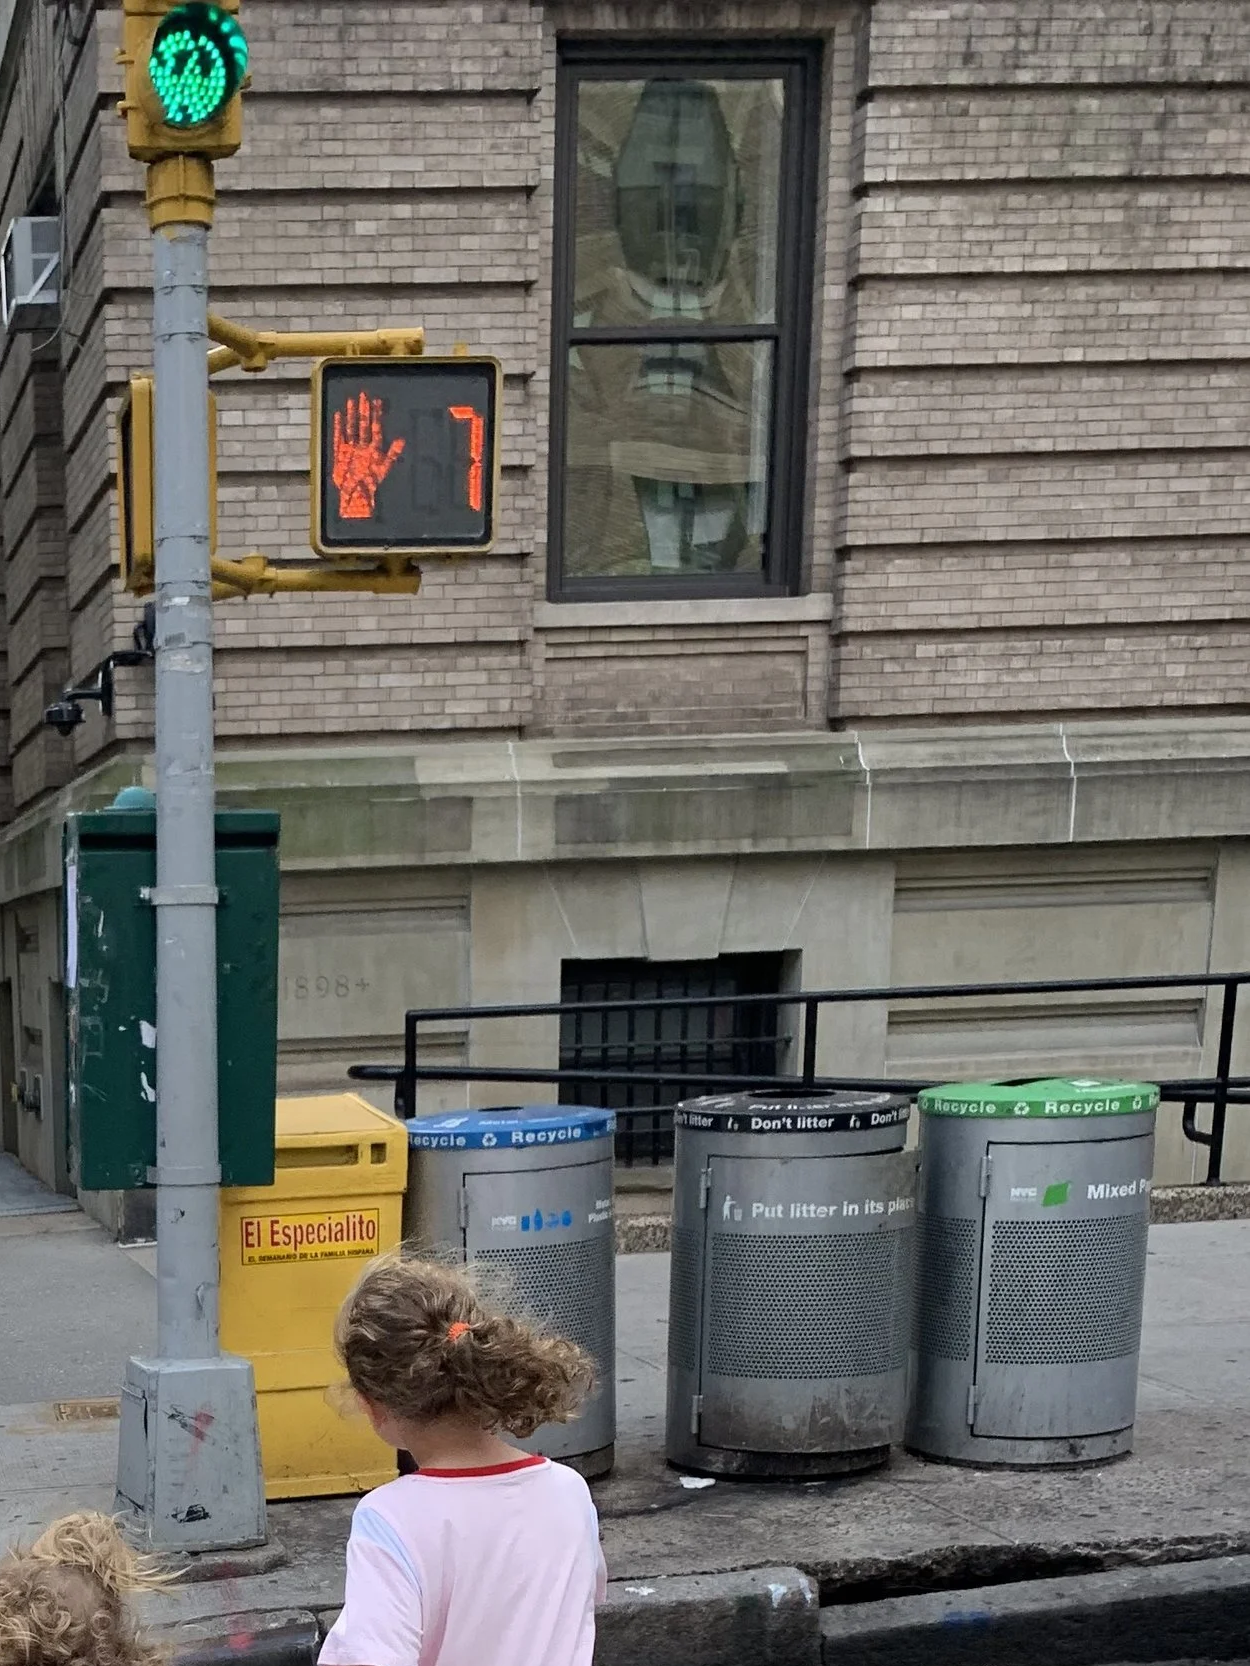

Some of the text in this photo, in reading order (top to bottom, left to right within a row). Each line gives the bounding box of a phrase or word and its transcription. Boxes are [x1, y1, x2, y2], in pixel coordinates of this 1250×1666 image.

[449, 406, 484, 511] 7
[934, 1098, 1120, 1115] Recycle Recycle
[751, 1116, 835, 1130] Don't litter
[871, 1109, 898, 1126] Don't
[511, 1126, 582, 1145] Recycle
[1010, 1187, 1038, 1197] NYC
[1087, 1181, 1137, 1200] Mixed
[752, 1203, 784, 1218] Put
[790, 1203, 838, 1218] litter
[842, 1200, 859, 1217] in
[864, 1198, 884, 1214] its
[244, 1214, 376, 1251] El Especialito
[299, 1252, 308, 1260] DE
[310, 1251, 319, 1259] LA
[320, 1250, 346, 1258] FAMILIA
